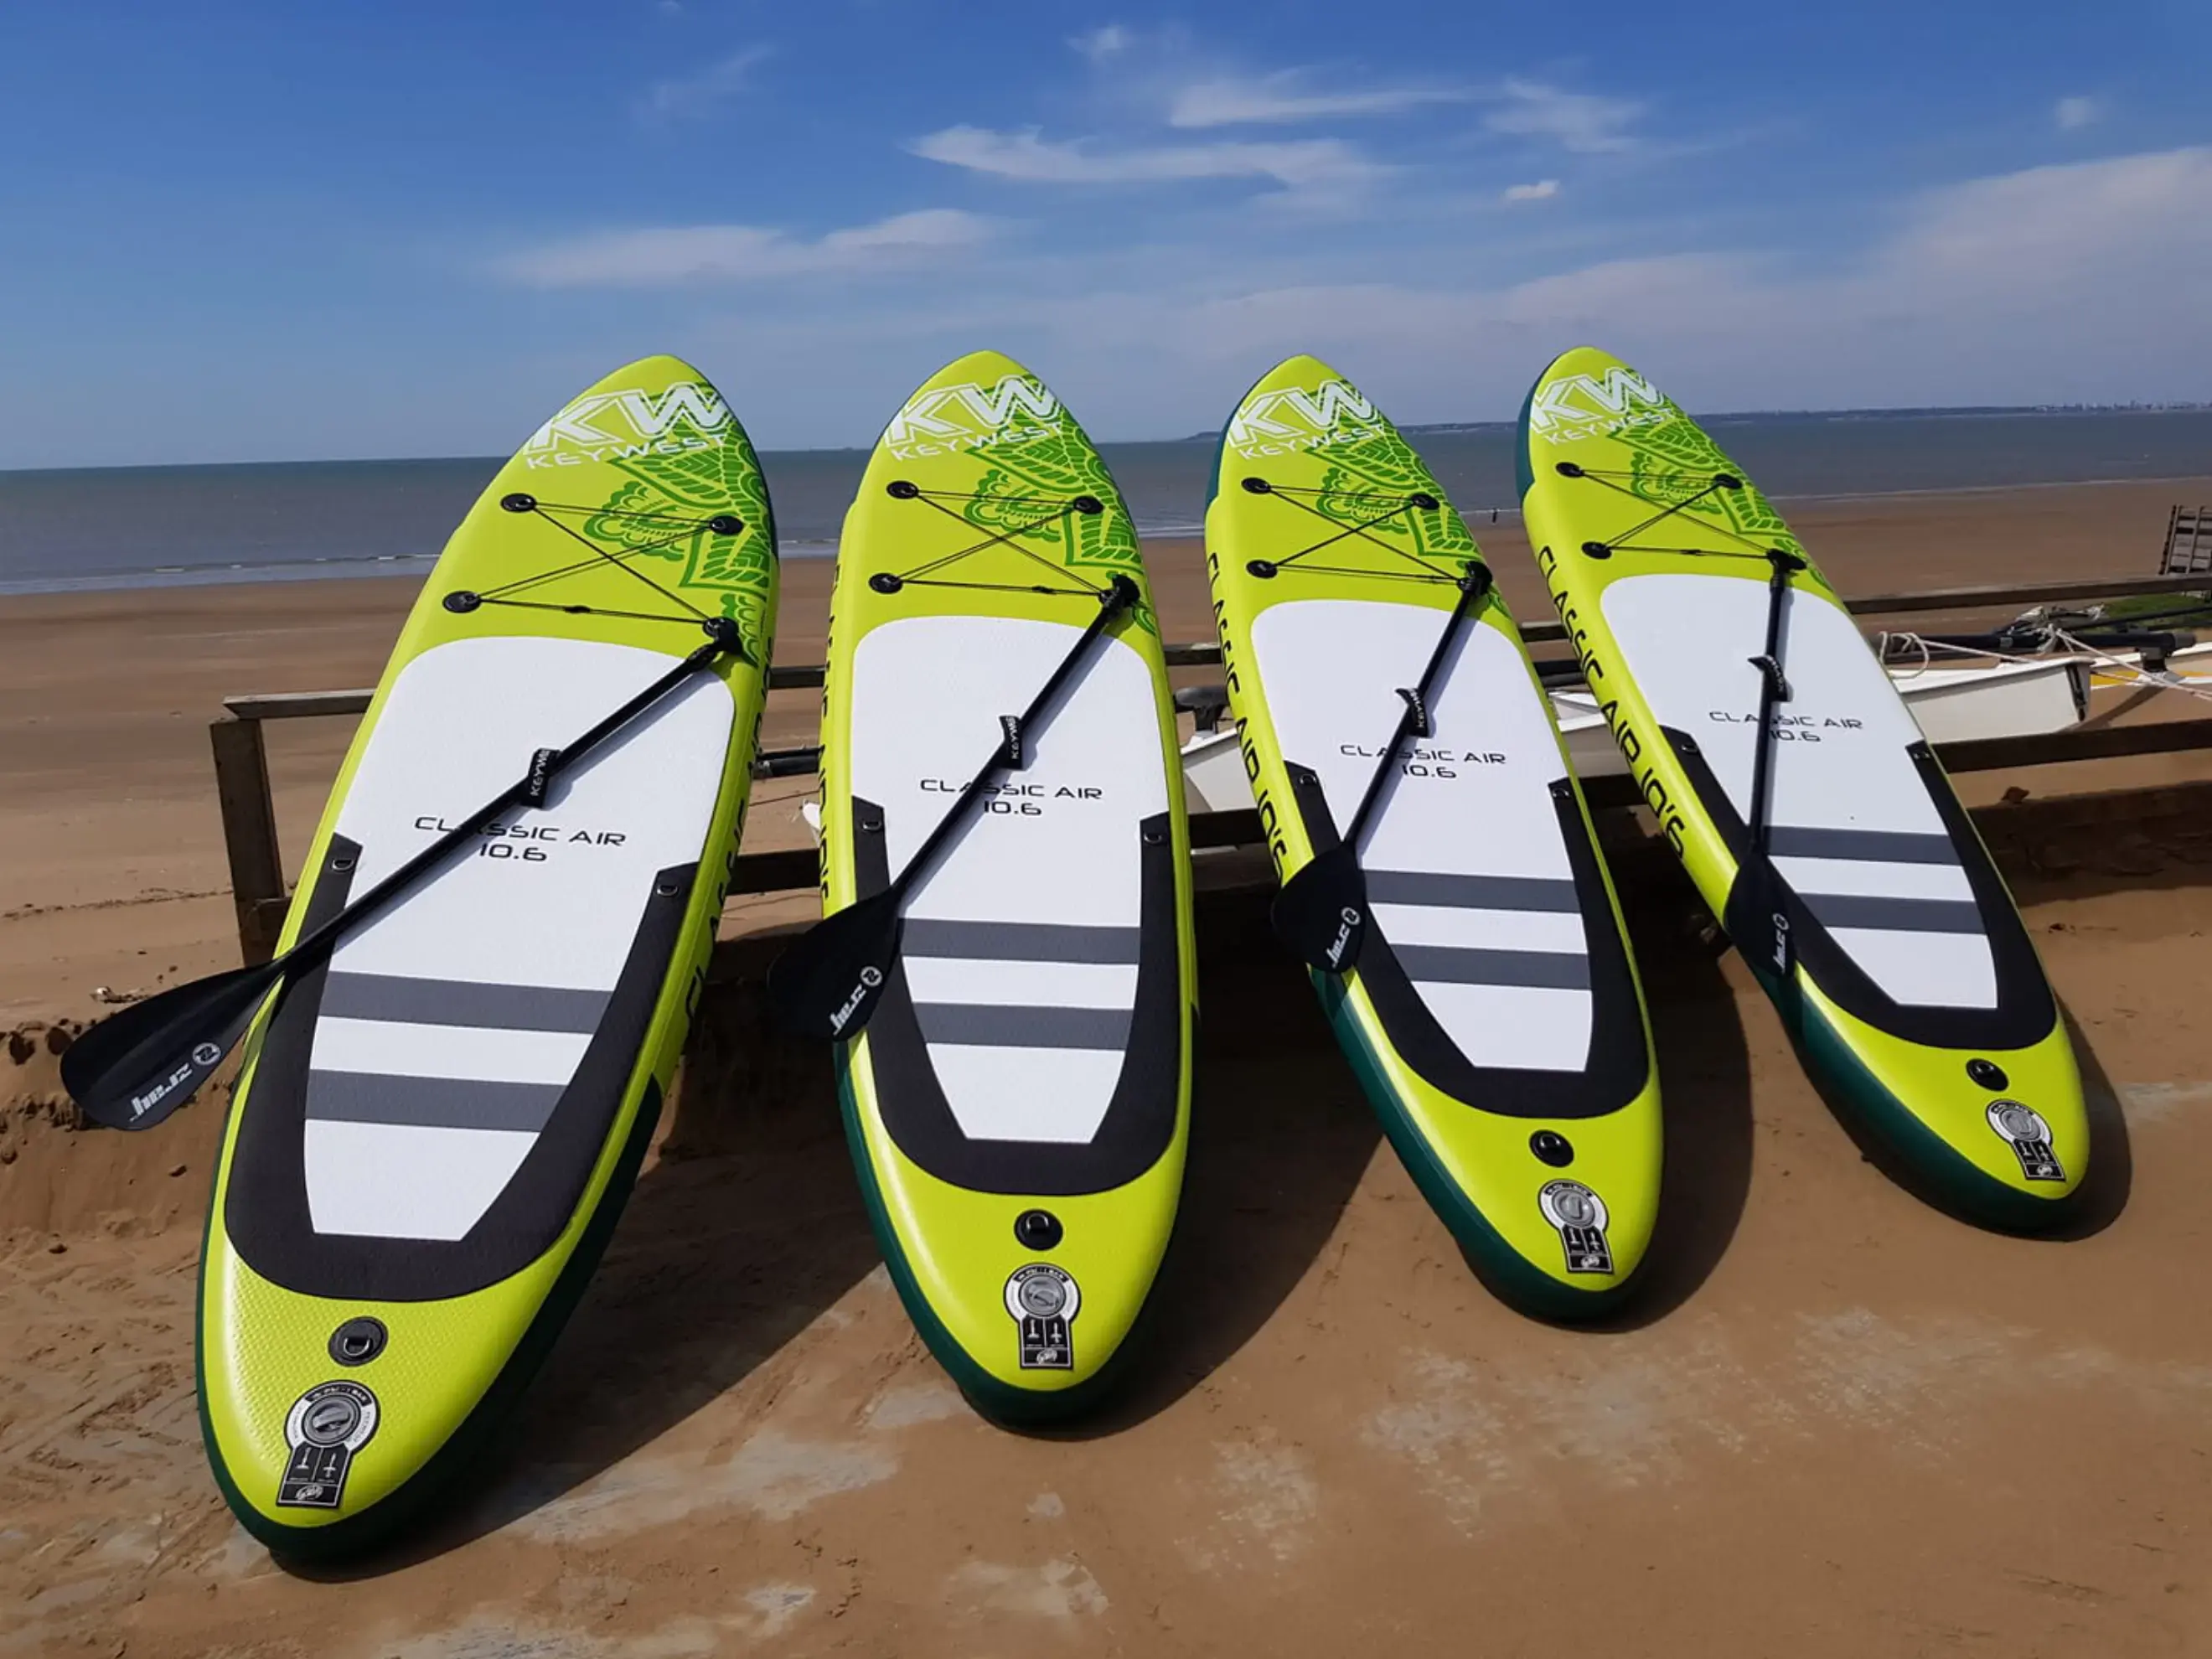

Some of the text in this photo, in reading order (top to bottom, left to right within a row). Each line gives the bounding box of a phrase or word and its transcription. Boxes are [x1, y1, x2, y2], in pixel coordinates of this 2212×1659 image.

[1530, 366, 1665, 436] KW
[521, 381, 733, 457] KW
[884, 373, 1065, 449] KW
[1225, 378, 1381, 449] KW
[1823, 716, 1864, 730] AIR
[1770, 729, 1822, 742] 10.6
[1463, 751, 1507, 765] AIR
[1401, 764, 1458, 779] 10.6
[1054, 786, 1103, 799] AIR
[983, 800, 1042, 816] 10.6
[413, 815, 628, 847] CLSSIC AIR
[479, 843, 548, 862] 10.6
